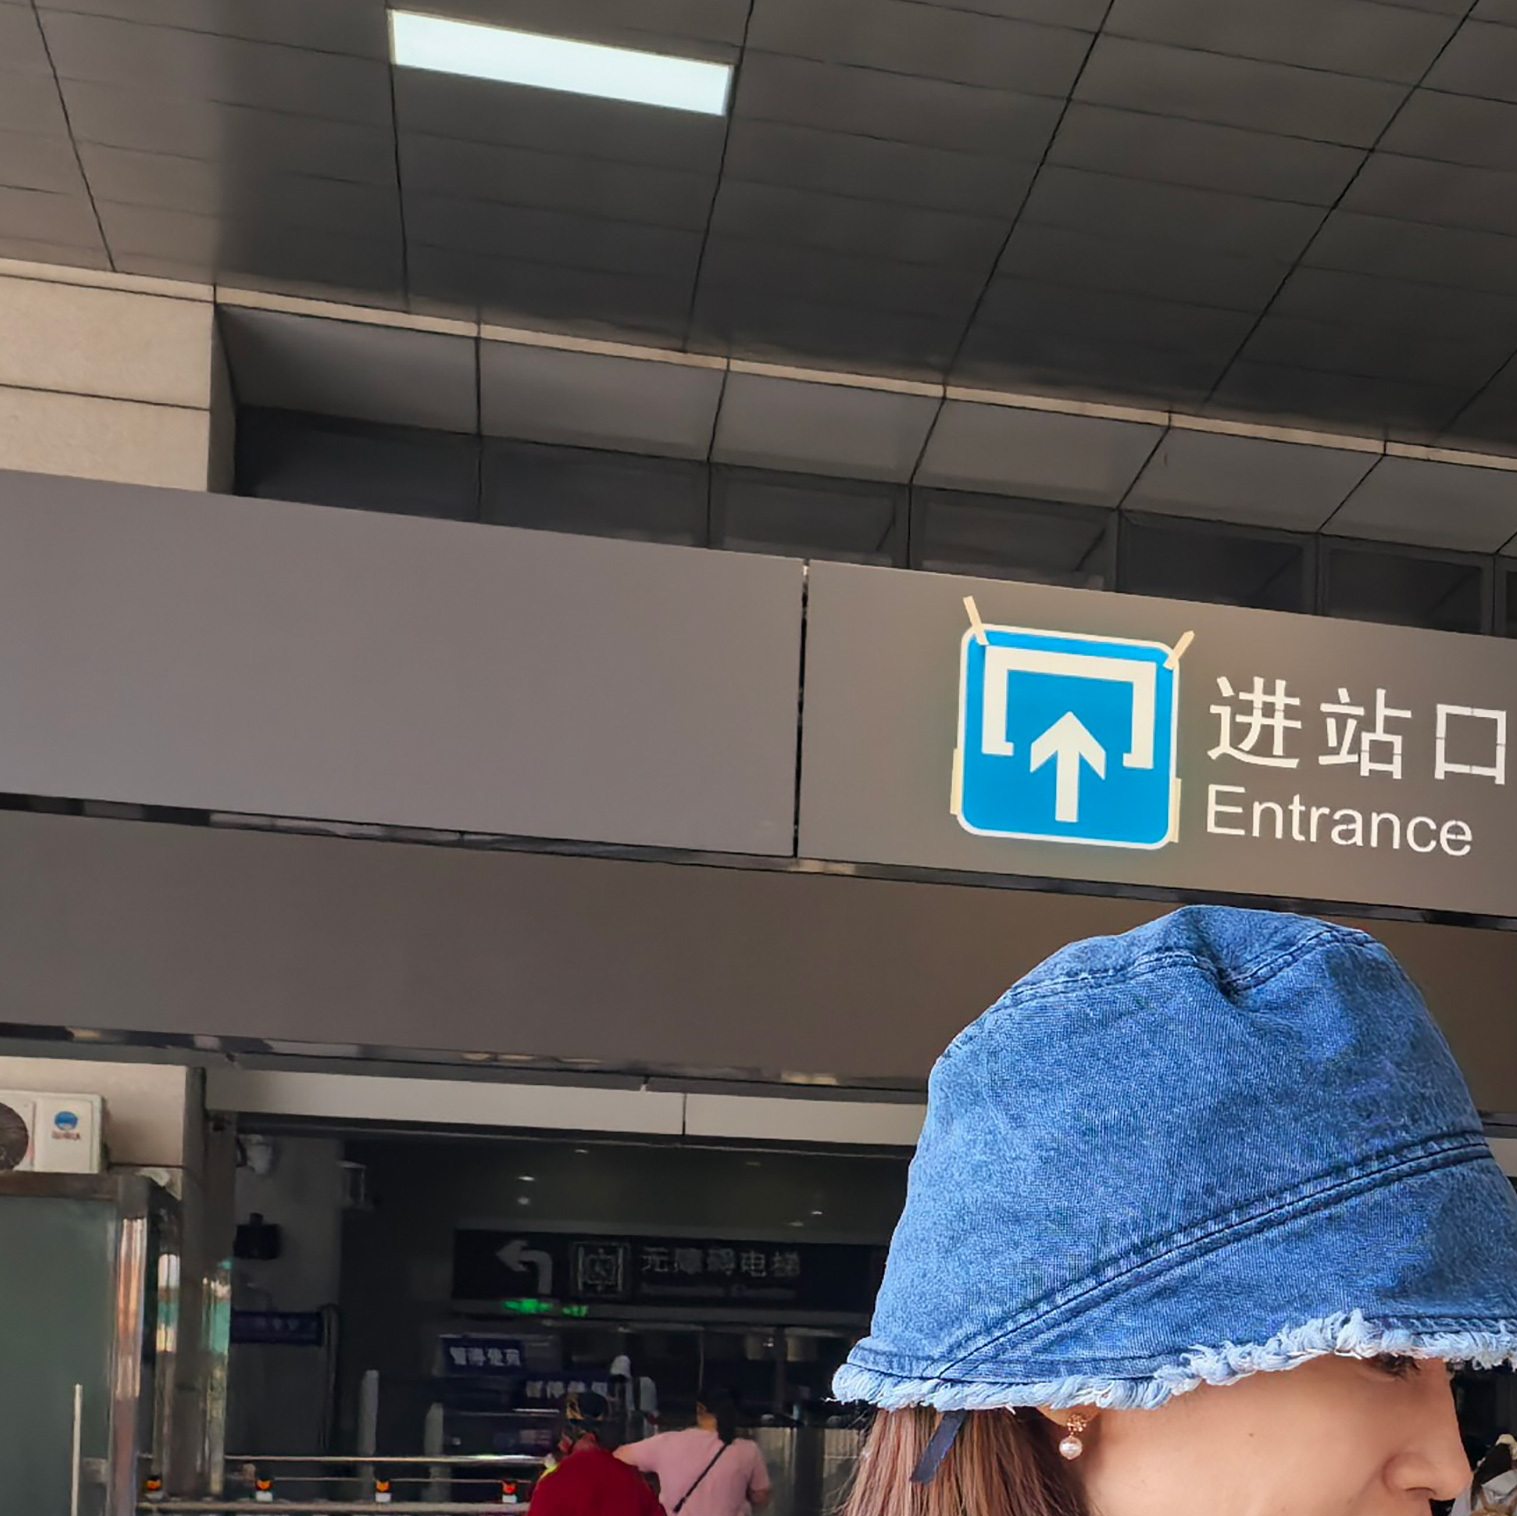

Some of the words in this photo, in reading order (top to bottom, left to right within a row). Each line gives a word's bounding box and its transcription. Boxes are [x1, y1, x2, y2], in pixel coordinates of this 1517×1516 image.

[1206, 676, 1508, 785] 进站口
[1206, 784, 1473, 857] Entrance
